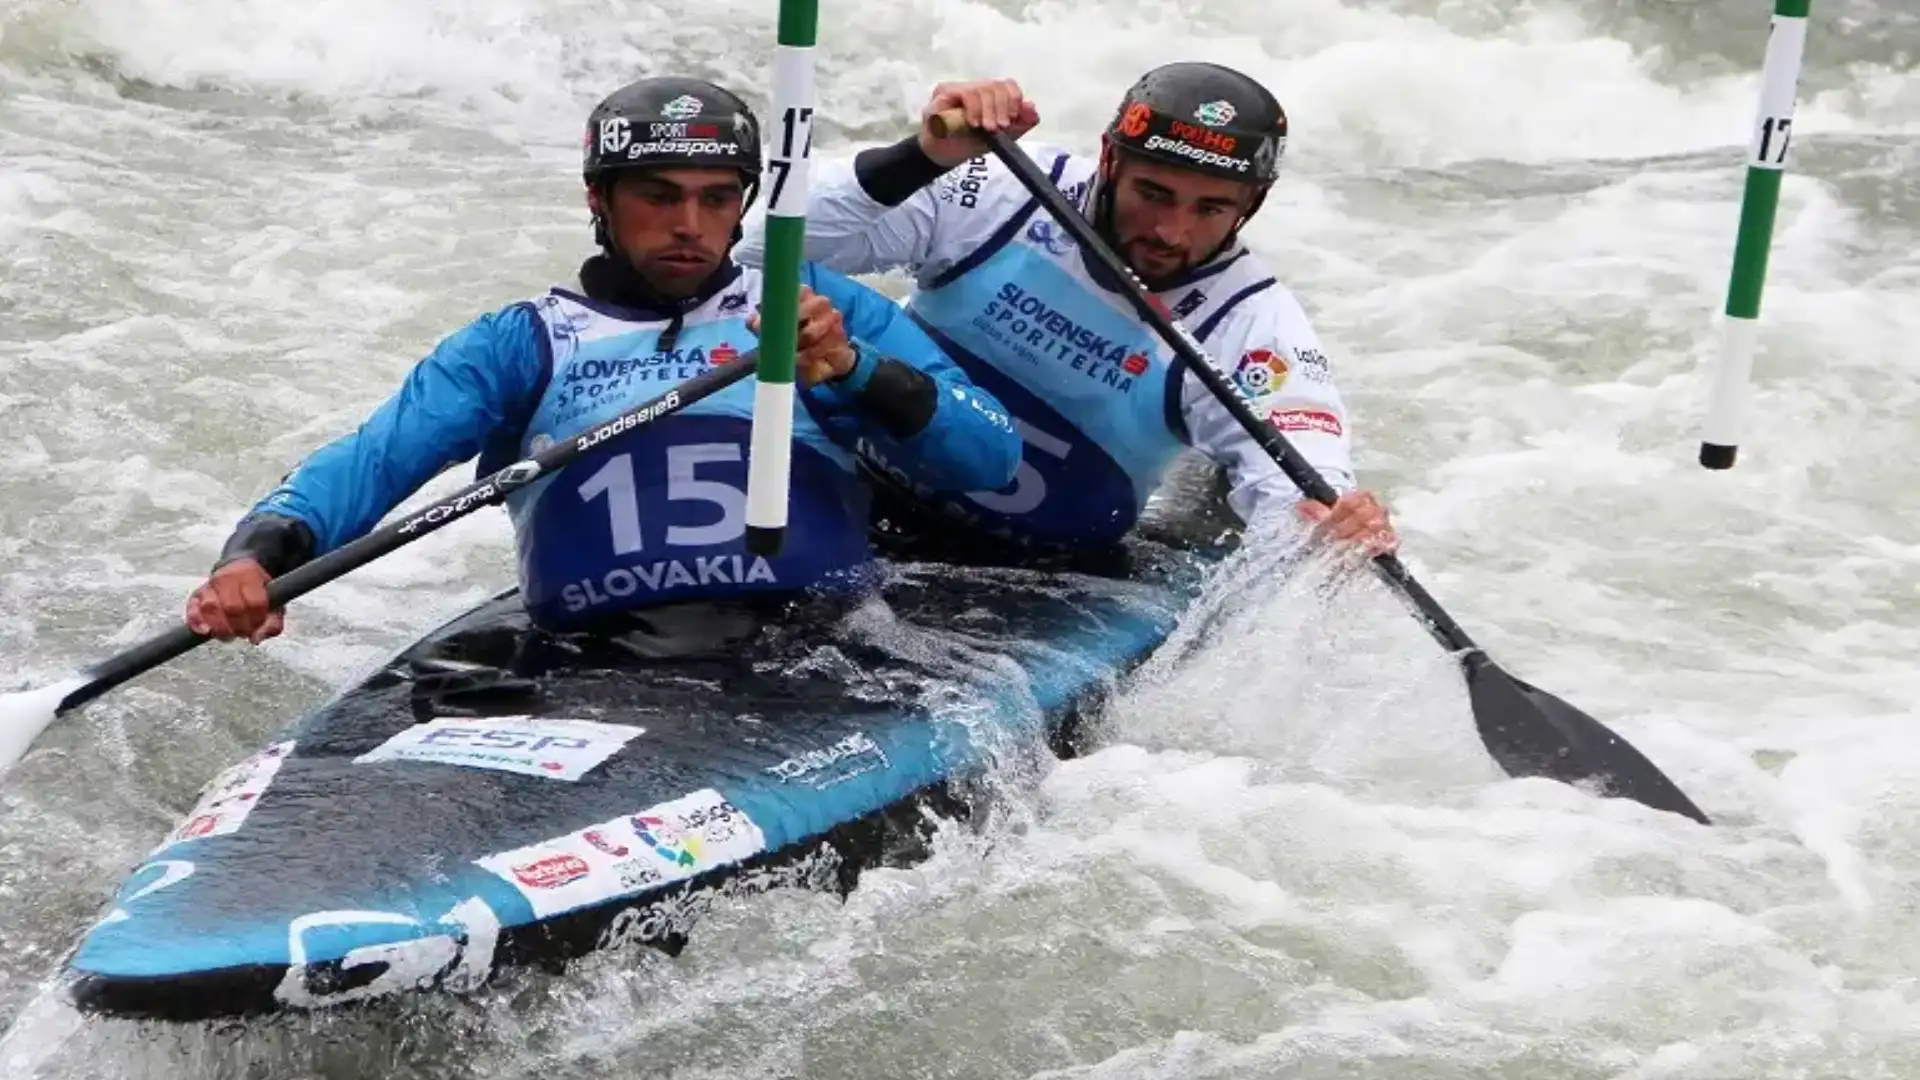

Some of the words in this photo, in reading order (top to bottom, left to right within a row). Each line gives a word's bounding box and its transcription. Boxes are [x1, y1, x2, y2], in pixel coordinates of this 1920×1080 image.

[628, 140, 739, 158] galasport
[782, 107, 813, 158] 17
[1144, 134, 1251, 172] galasport
[1758, 116, 1792, 163] 17
[997, 282, 1130, 367] SLOVENSKÁ
[562, 345, 706, 387] SLOVENSKÁ
[577, 390, 680, 451] galasport
[577, 443, 747, 556] 15
[560, 555, 779, 612] SLOVAKIA
